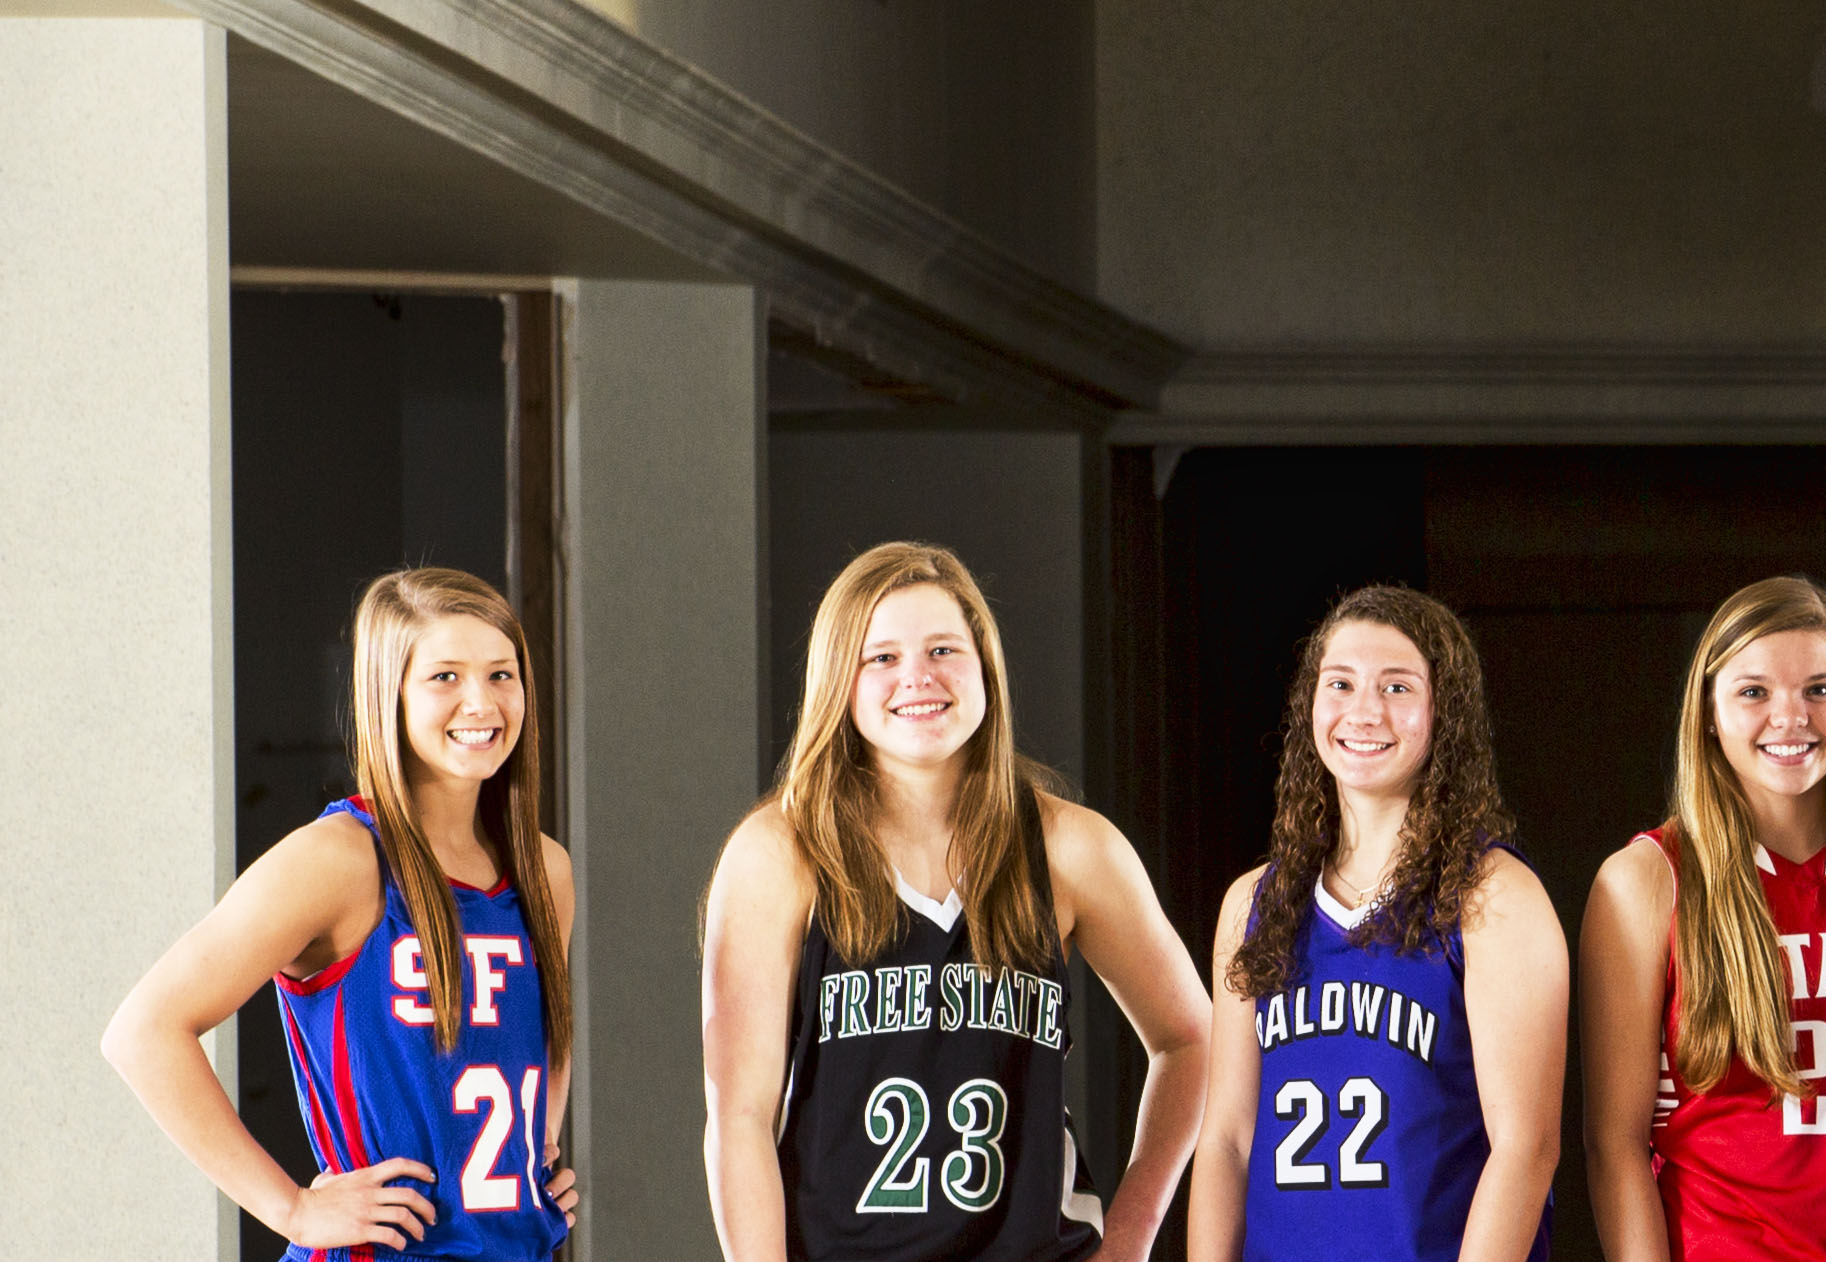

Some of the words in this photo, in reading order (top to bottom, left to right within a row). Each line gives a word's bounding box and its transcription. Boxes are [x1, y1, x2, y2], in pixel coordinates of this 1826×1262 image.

[391, 934, 537, 1027] SF
[818, 964, 932, 1044] FREE
[940, 963, 1062, 1050] STATE
[452, 1064, 542, 1213] 21
[856, 1077, 1008, 1213] 23
[1275, 1077, 1388, 1190] 22
